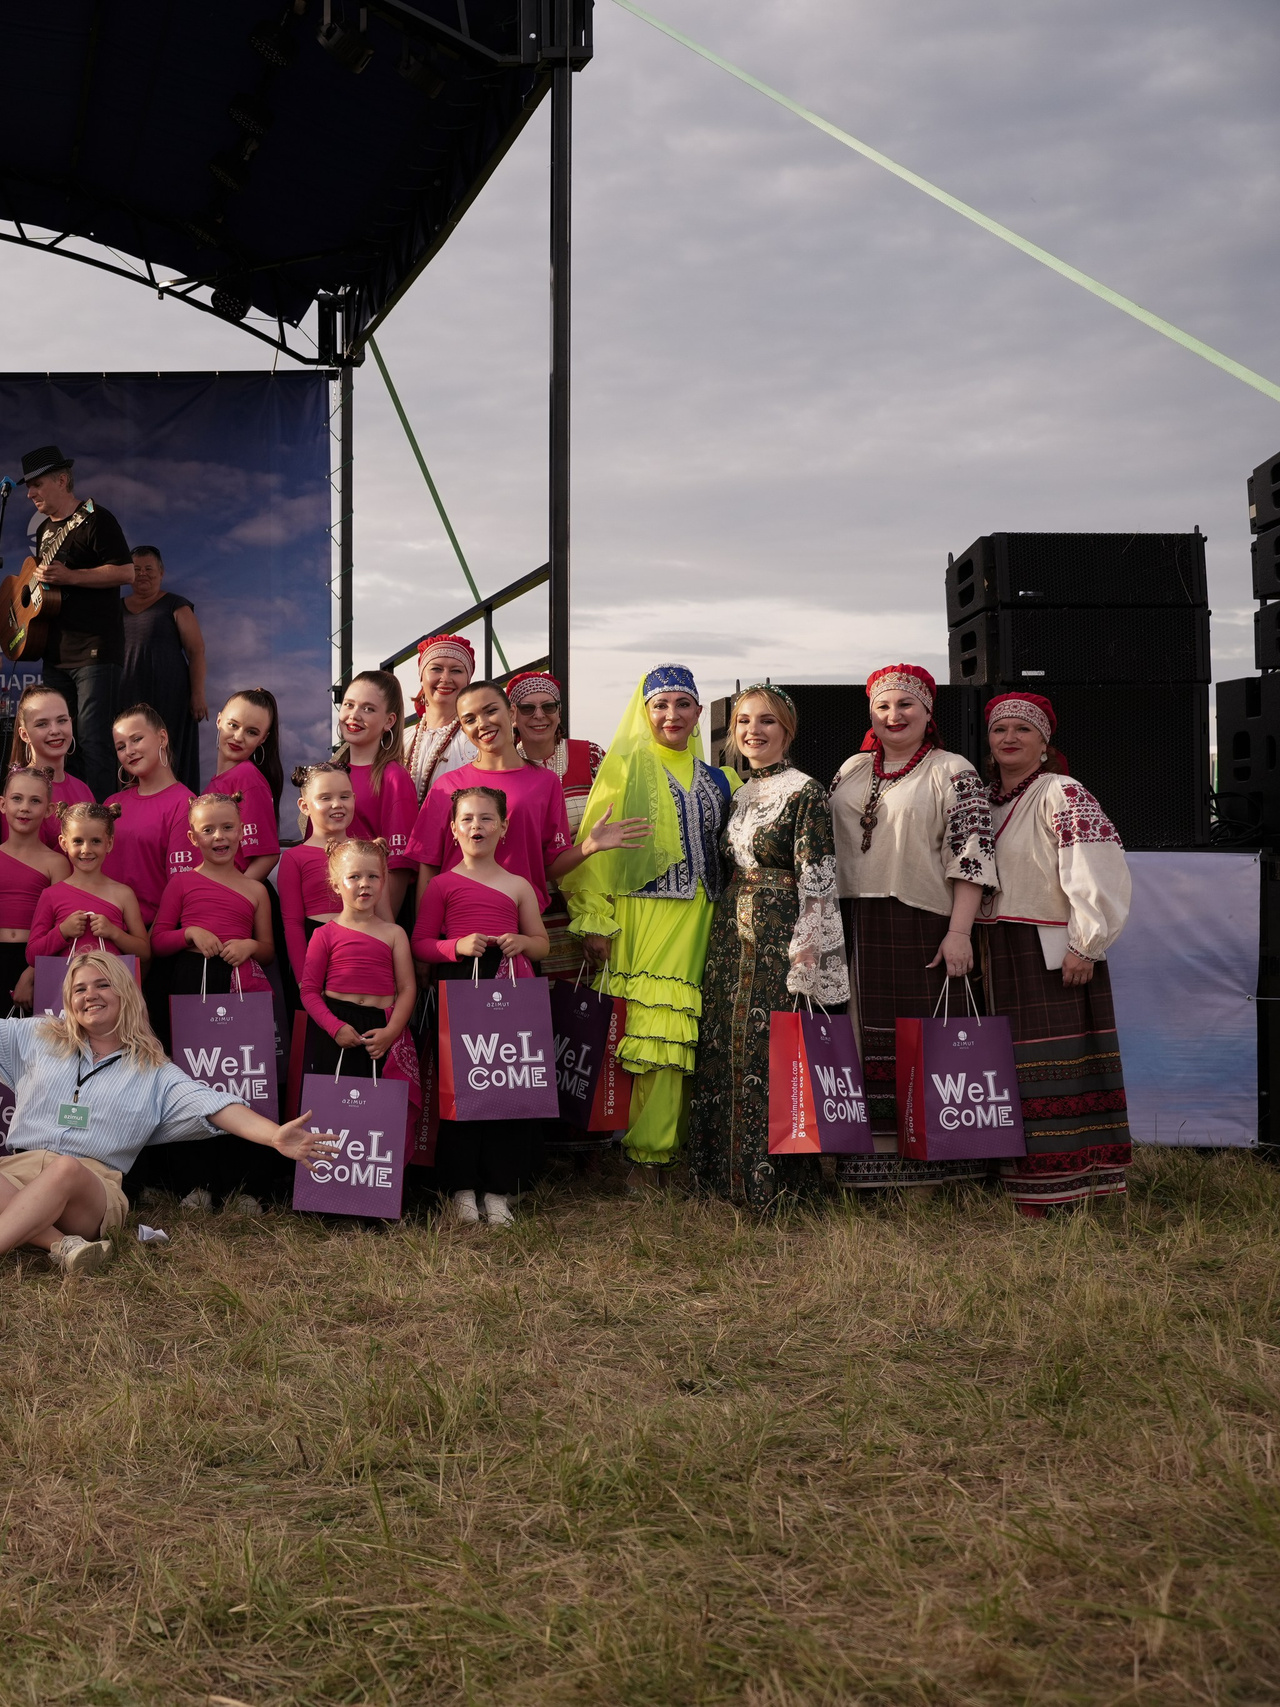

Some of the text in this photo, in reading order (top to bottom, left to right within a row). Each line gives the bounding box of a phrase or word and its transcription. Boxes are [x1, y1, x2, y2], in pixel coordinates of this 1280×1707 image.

[609, 1013, 618, 1042] 0000
[183, 1045, 266, 1077] WeL
[461, 1031, 544, 1065] WeL
[609, 1057, 615, 1068] 00
[468, 1065, 547, 1090] CoME
[815, 1065, 863, 1098] WeL
[931, 1070, 1010, 1104] WeL
[607, 1089, 615, 1107] 800
[824, 1099, 867, 1123] CoME
[939, 1104, 1014, 1130] CoME
[419, 1125, 428, 1143] 800
[310, 1160, 393, 1188] CoME
